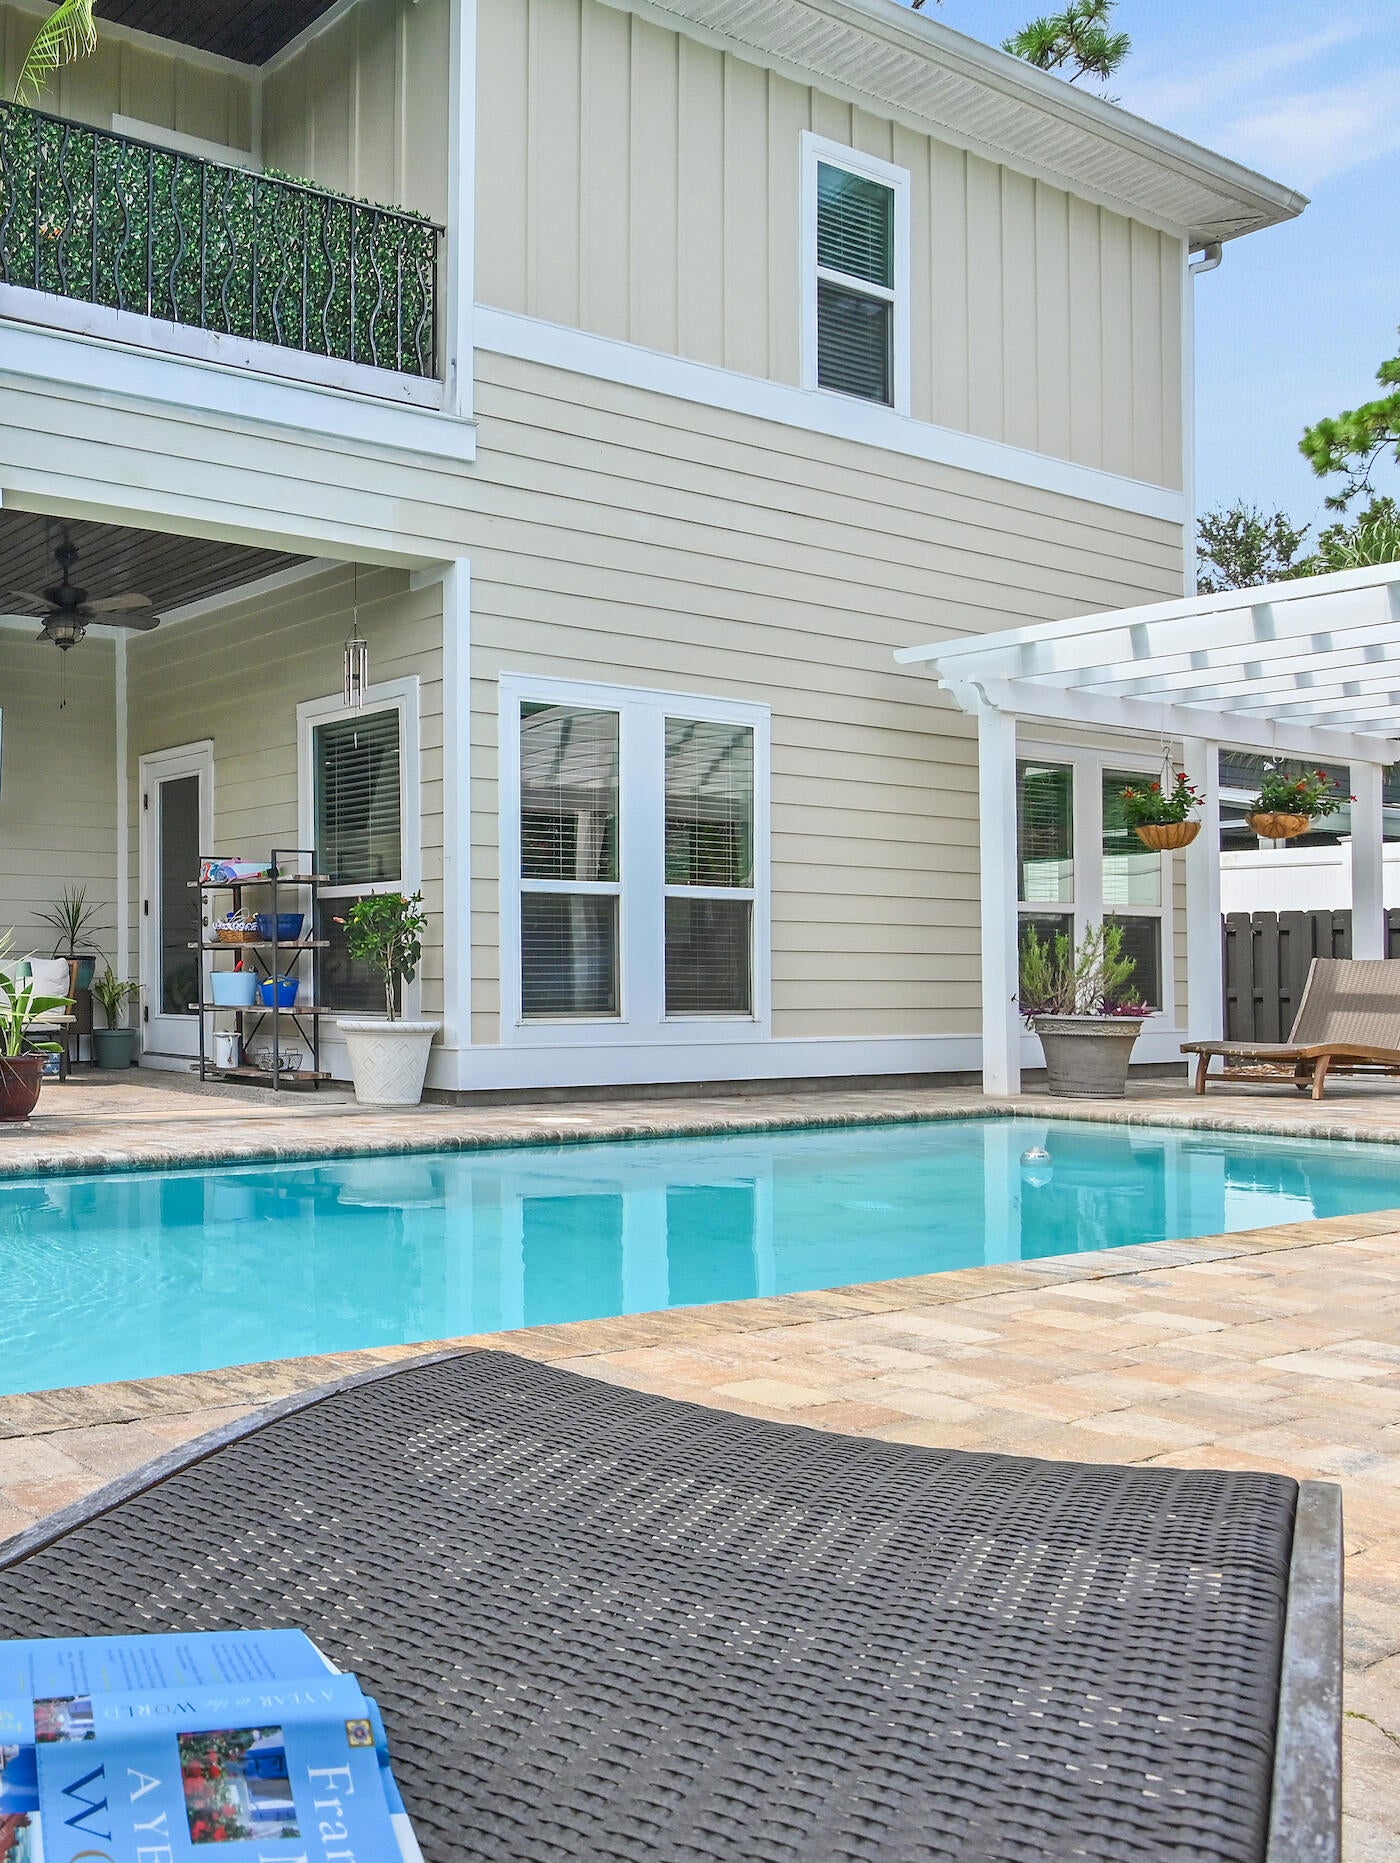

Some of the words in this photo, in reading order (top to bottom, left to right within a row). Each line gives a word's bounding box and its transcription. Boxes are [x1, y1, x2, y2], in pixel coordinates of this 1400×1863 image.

[259, 1691, 315, 1707] YEAR
[104, 1702, 198, 1720] WORLD
[127, 1767, 162, 1804] A
